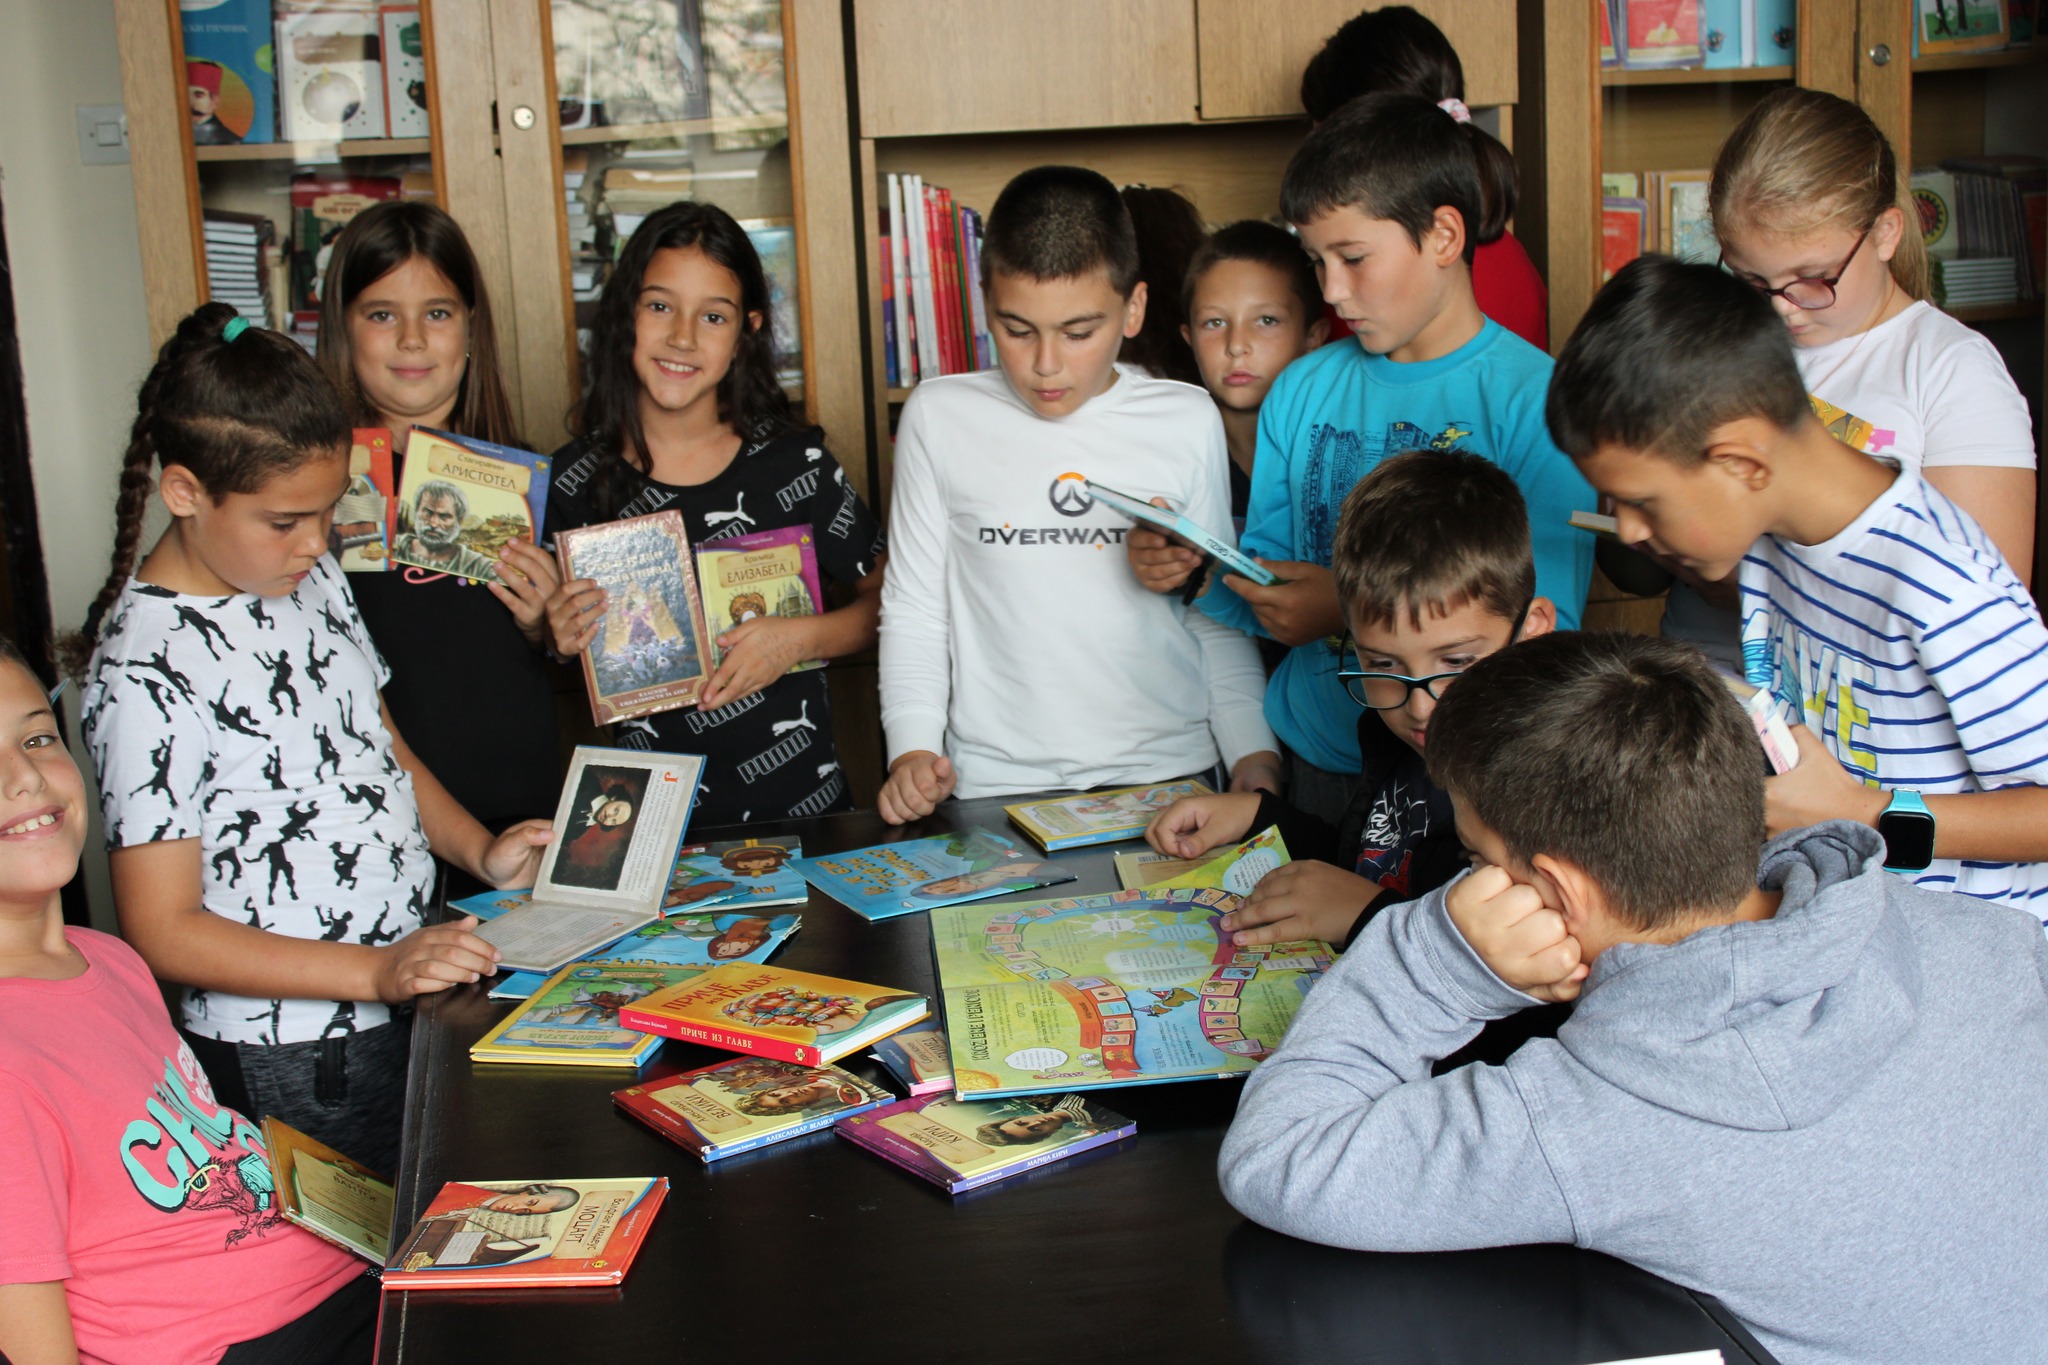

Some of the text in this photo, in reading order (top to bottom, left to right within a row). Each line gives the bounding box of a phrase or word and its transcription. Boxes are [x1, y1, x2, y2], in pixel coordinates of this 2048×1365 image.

[441, 463, 516, 491] АРИСТОТЕЛ
[727, 562, 787, 584] ЕЛИЗАБЕТА
[737, 728, 812, 785] PUMA
[661, 981, 734, 1012] ПРИЧЕ
[722, 973, 783, 1000] ГЛАВЕ
[681, 1026, 754, 1049] ПРИЧЕ ИЗ ГЛАВЕ
[969, 1038, 990, 1061] KROZ
[684, 1093, 733, 1119] ВЕЛИКИ
[765, 1116, 835, 1143] АЛЕКСАНДАР ВЕЛИКИ
[922, 1125, 963, 1144] КИРИ
[1026, 1148, 1069, 1168] МАРИЈА КИРИ
[565, 1205, 601, 1244] МОЦАРТ
